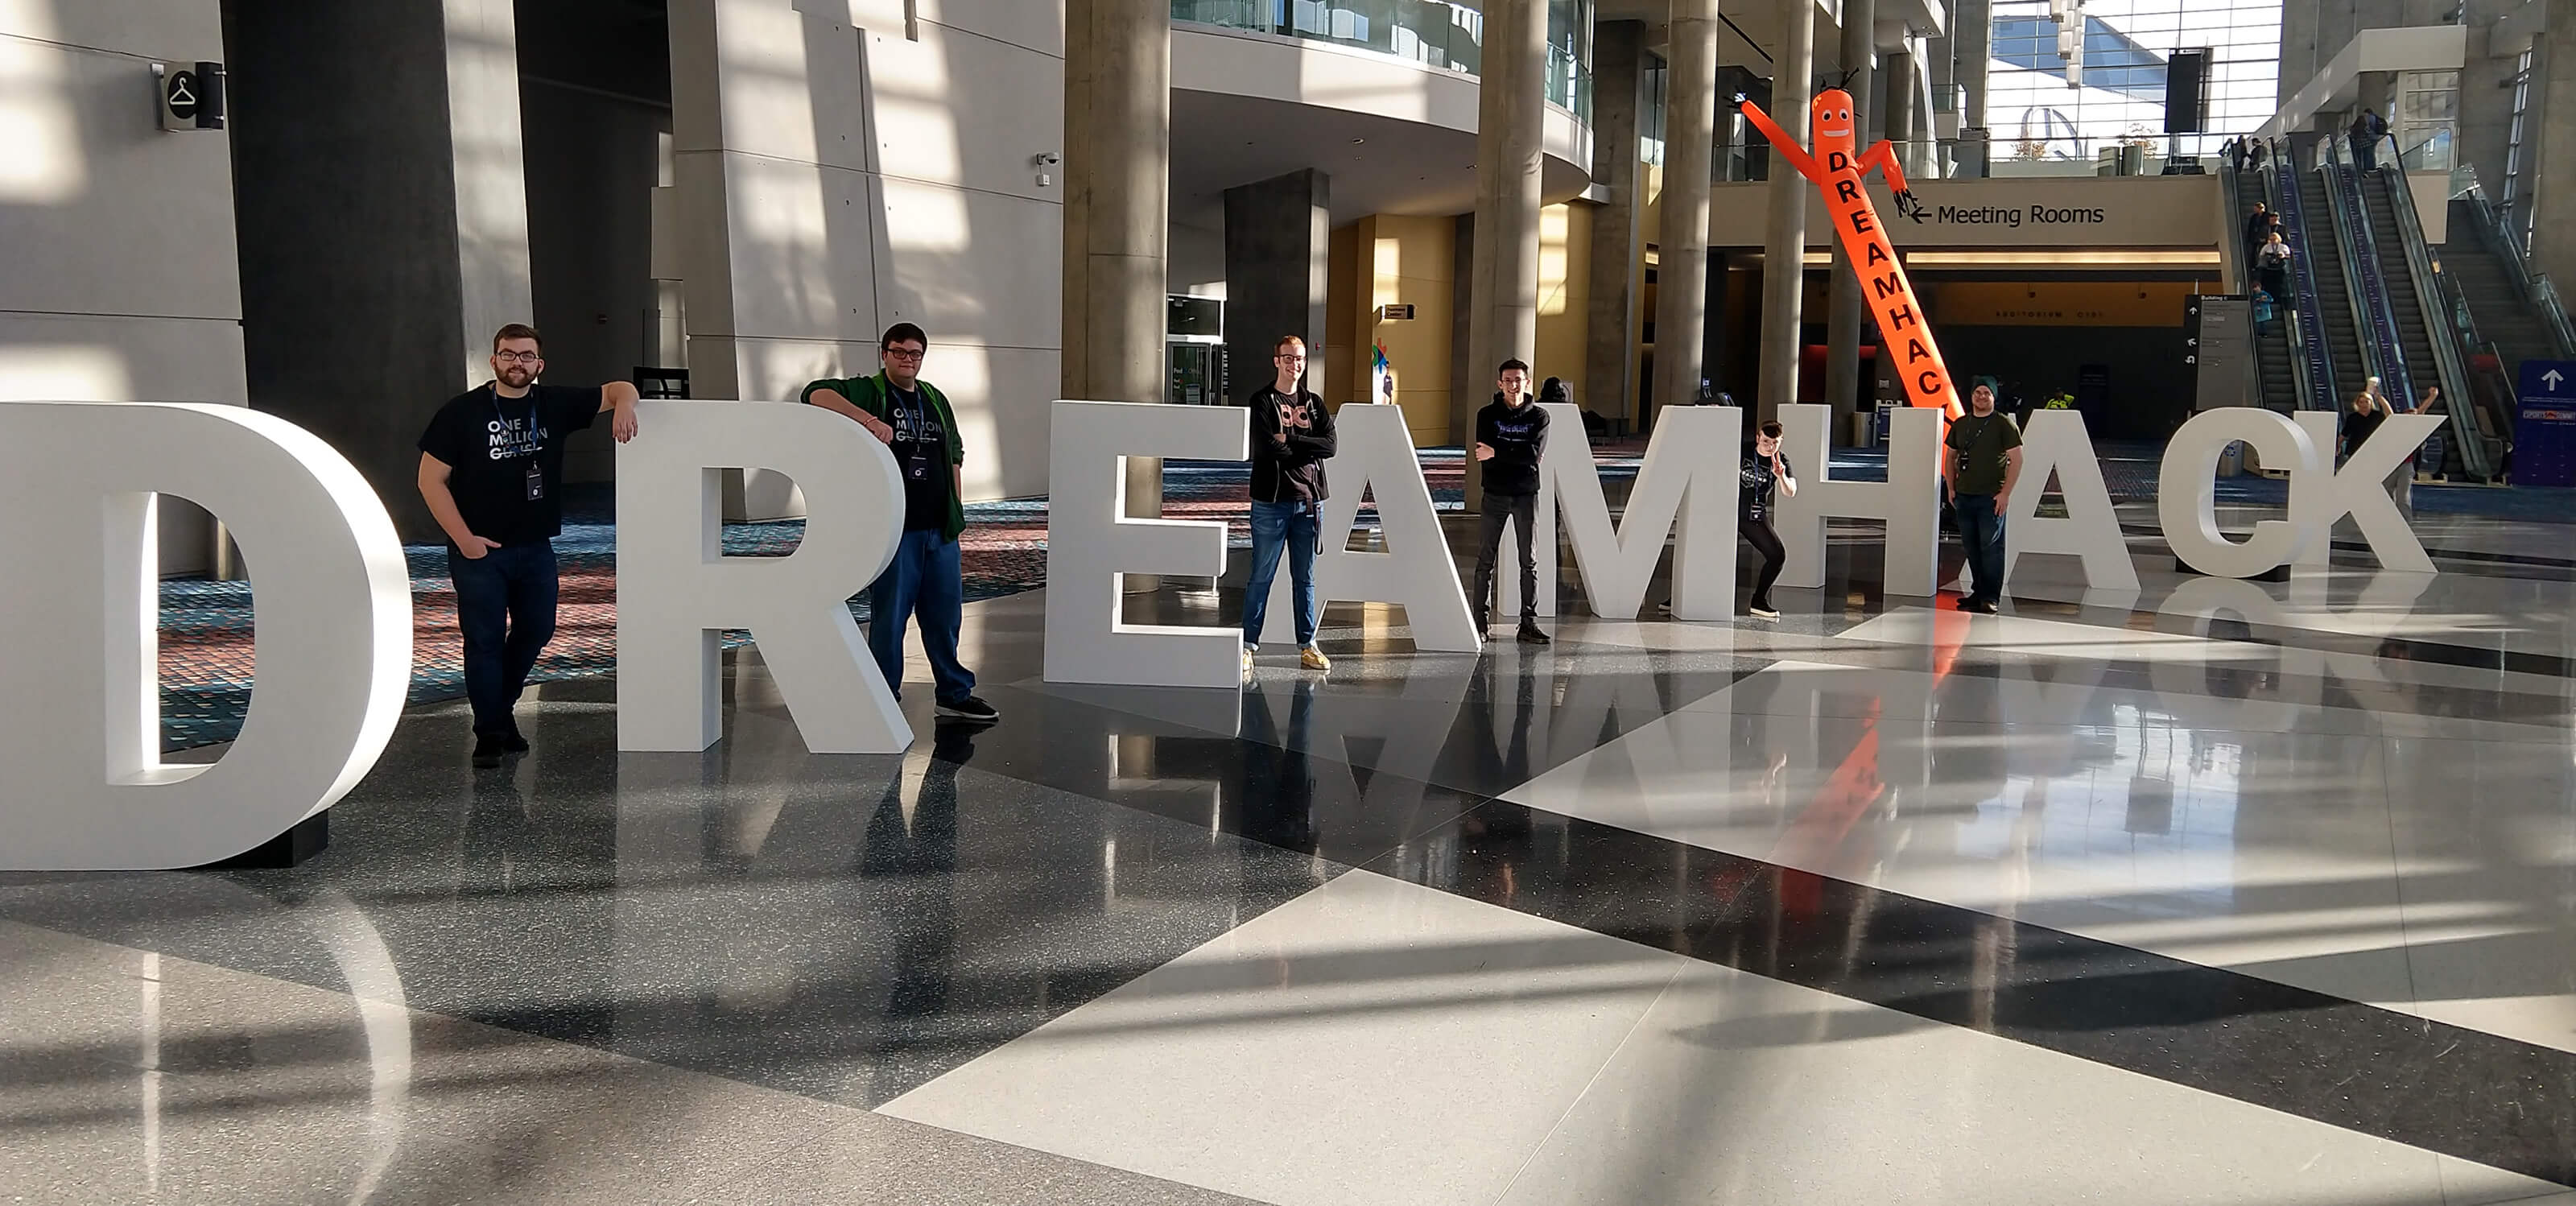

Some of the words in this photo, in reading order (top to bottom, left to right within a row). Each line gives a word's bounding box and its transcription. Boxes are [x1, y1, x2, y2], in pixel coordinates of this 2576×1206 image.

[1938, 205, 2021, 228] Meeting
[2030, 204, 2104, 223] Rooms
[0, 400, 2446, 870] DREAMHACK
